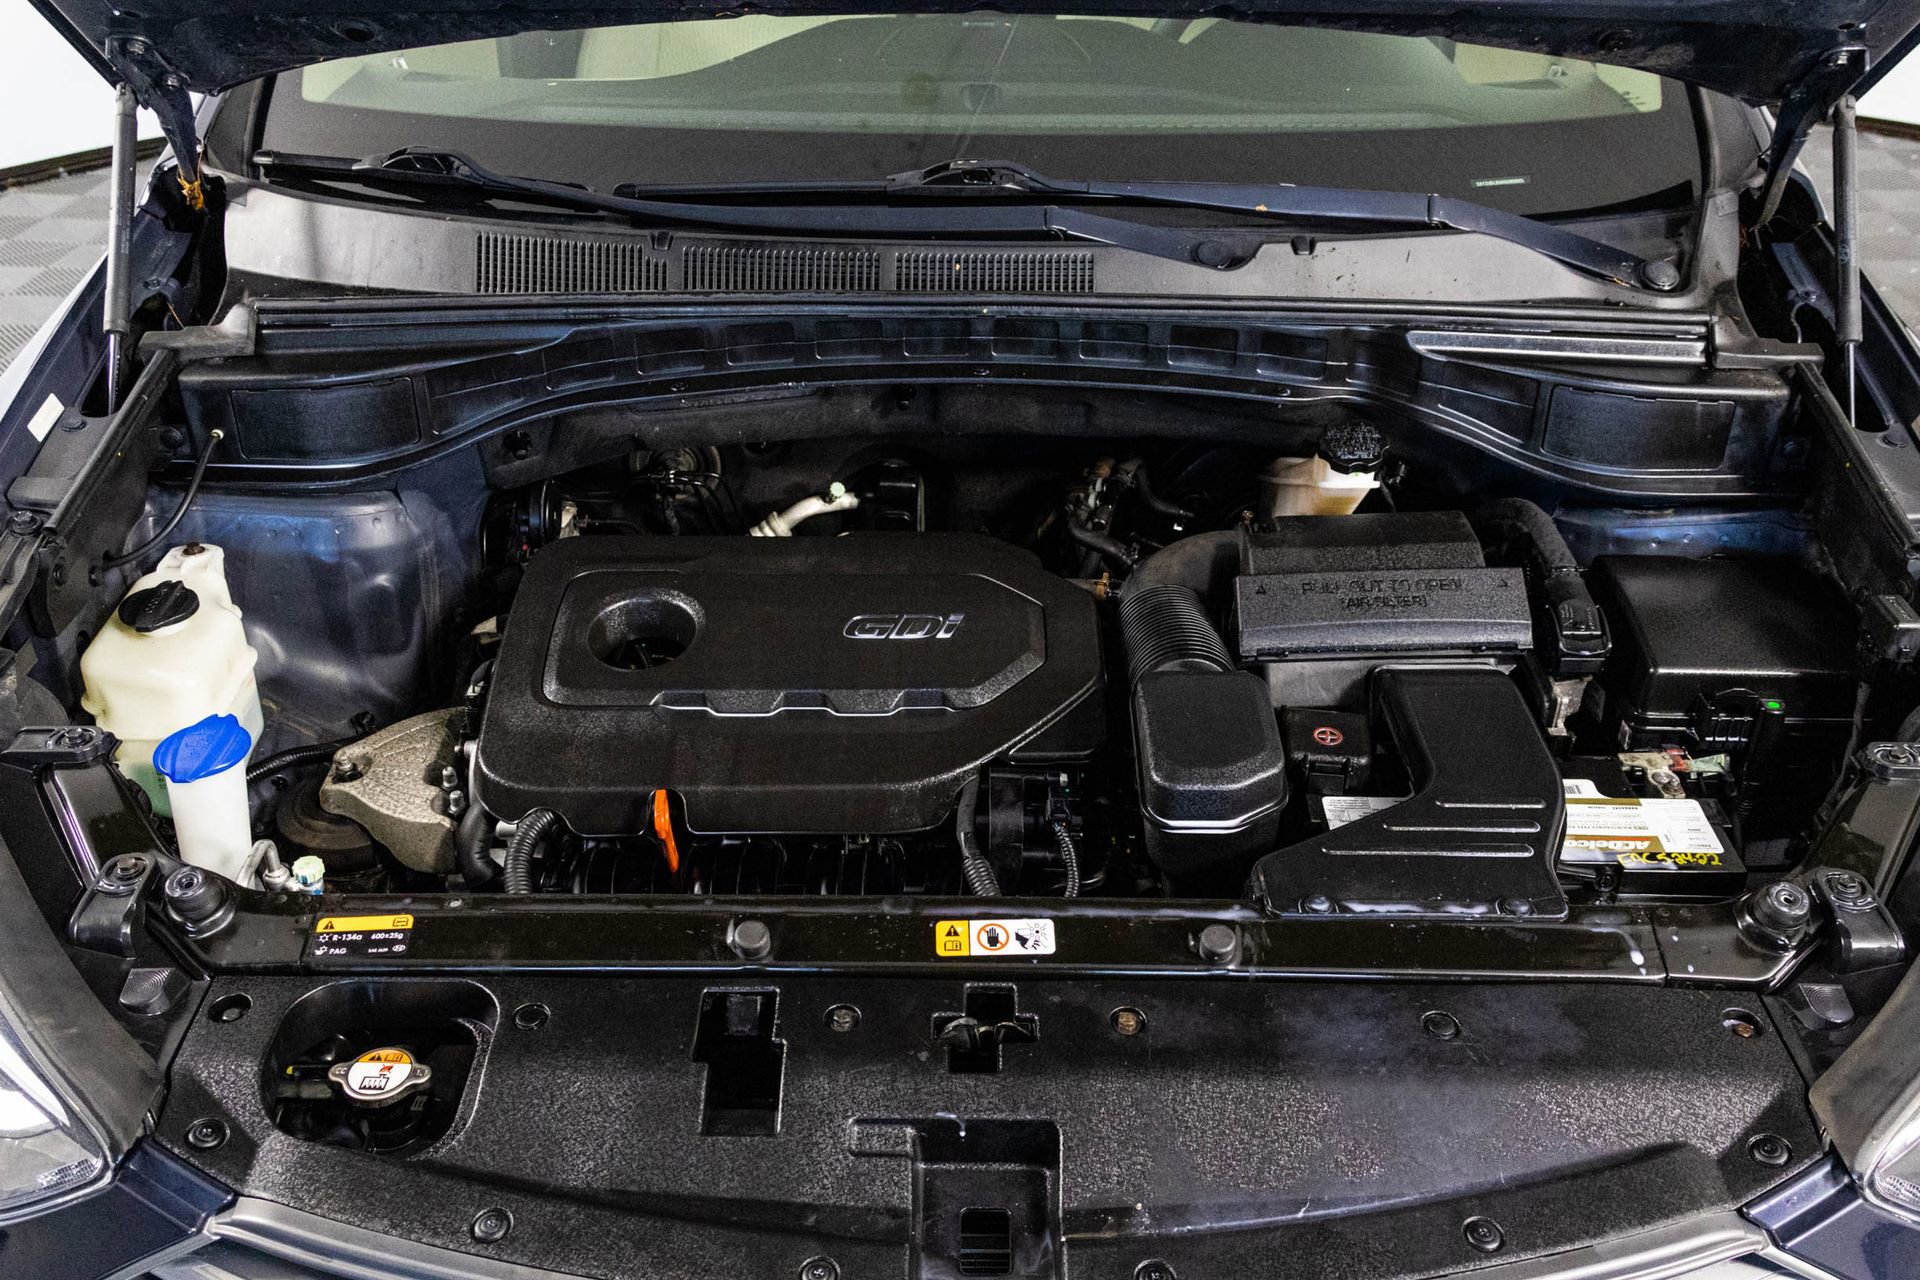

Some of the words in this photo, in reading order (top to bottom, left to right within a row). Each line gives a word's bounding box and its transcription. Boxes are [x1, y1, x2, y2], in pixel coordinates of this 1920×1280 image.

[842, 614, 965, 639] GDi
[332, 933, 363, 942] R-134a
[329, 947, 347, 955] PAG
